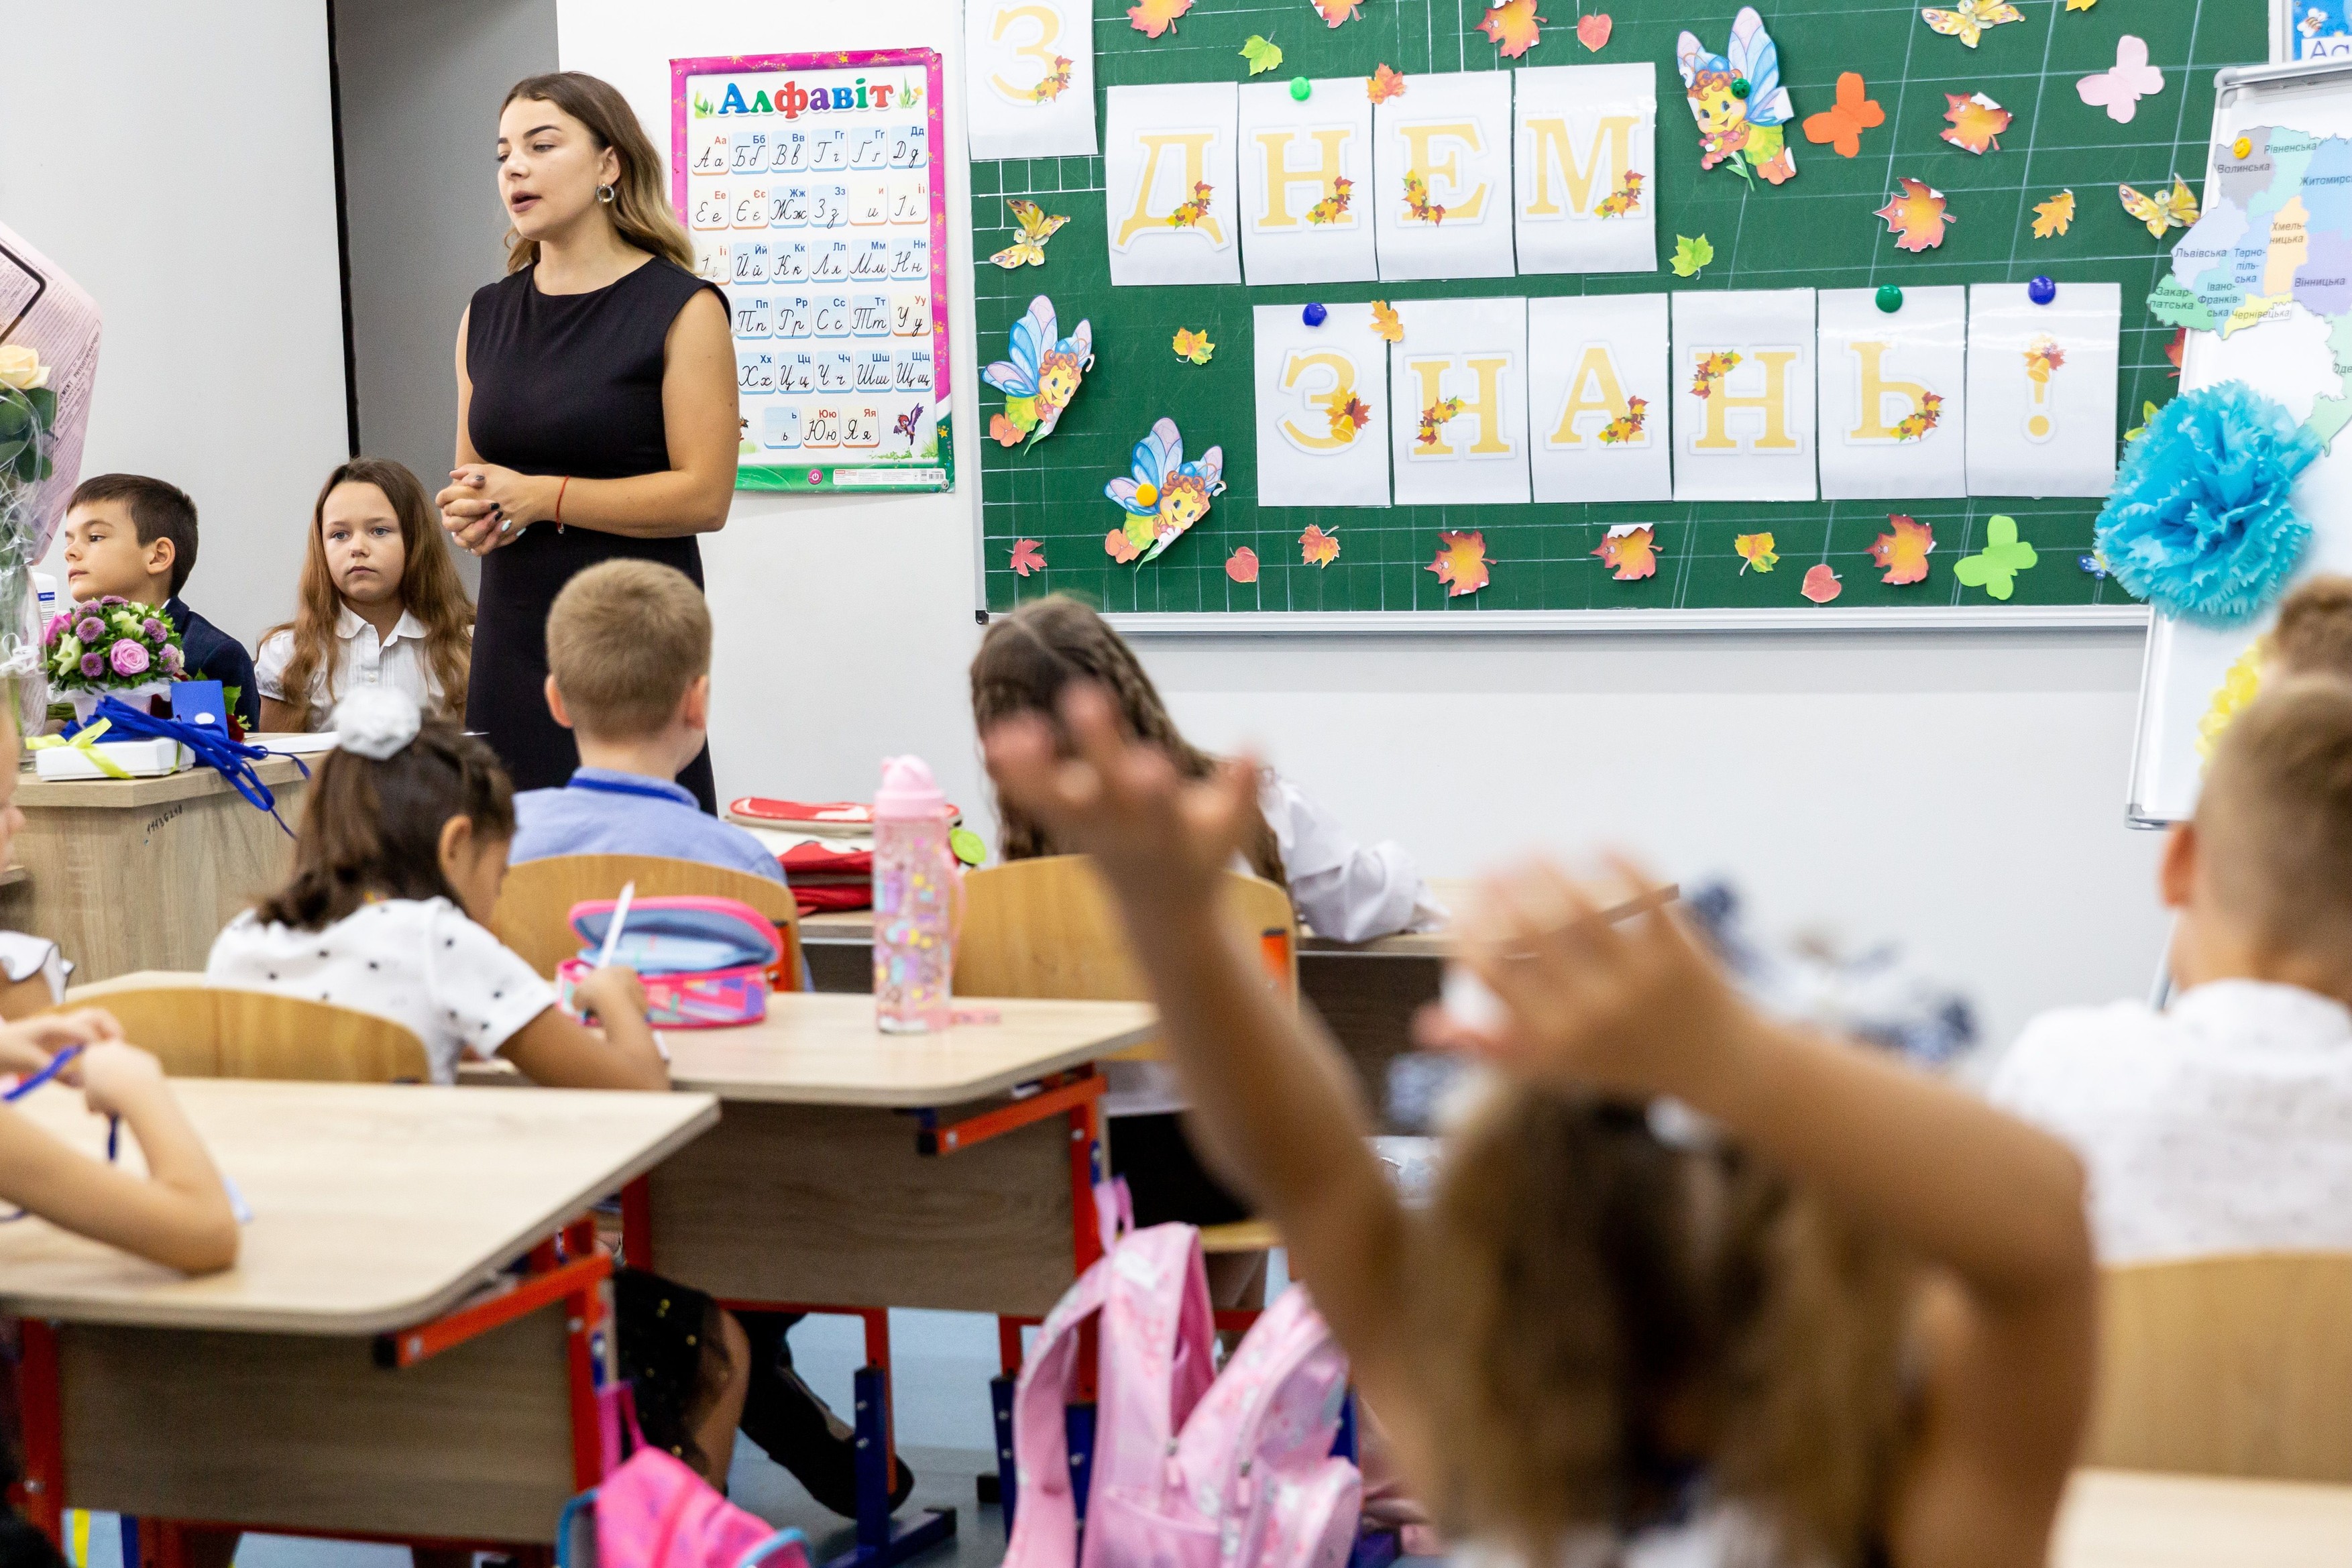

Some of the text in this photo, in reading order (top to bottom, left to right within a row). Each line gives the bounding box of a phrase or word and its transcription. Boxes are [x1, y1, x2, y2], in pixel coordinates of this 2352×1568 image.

[991, 5, 1065, 101] З
[718, 78, 893, 119] Алфавіт
[2263, 143, 2317, 154] Рівненська
[2217, 163, 2270, 174] Волинська
[1117, 117, 1641, 245] ДНЕМ
[2299, 176, 2352, 187] Житомирс
[2271, 222, 2306, 232] Хмель-
[2270, 235, 2304, 245] ницька
[2175, 247, 2227, 258] Львівська
[2234, 248, 2266, 259] Терно-
[2236, 262, 2259, 271] піль-
[2235, 274, 2257, 284] ська
[2294, 277, 2345, 287] Вінницька
[2155, 286, 2193, 298] Закар-
[2207, 282, 2236, 291] Івано-
[2149, 300, 2194, 311] патська
[2197, 295, 2241, 306] Франків-
[2206, 309, 2229, 318] ська
[2232, 310, 2290, 320] Чернівецька
